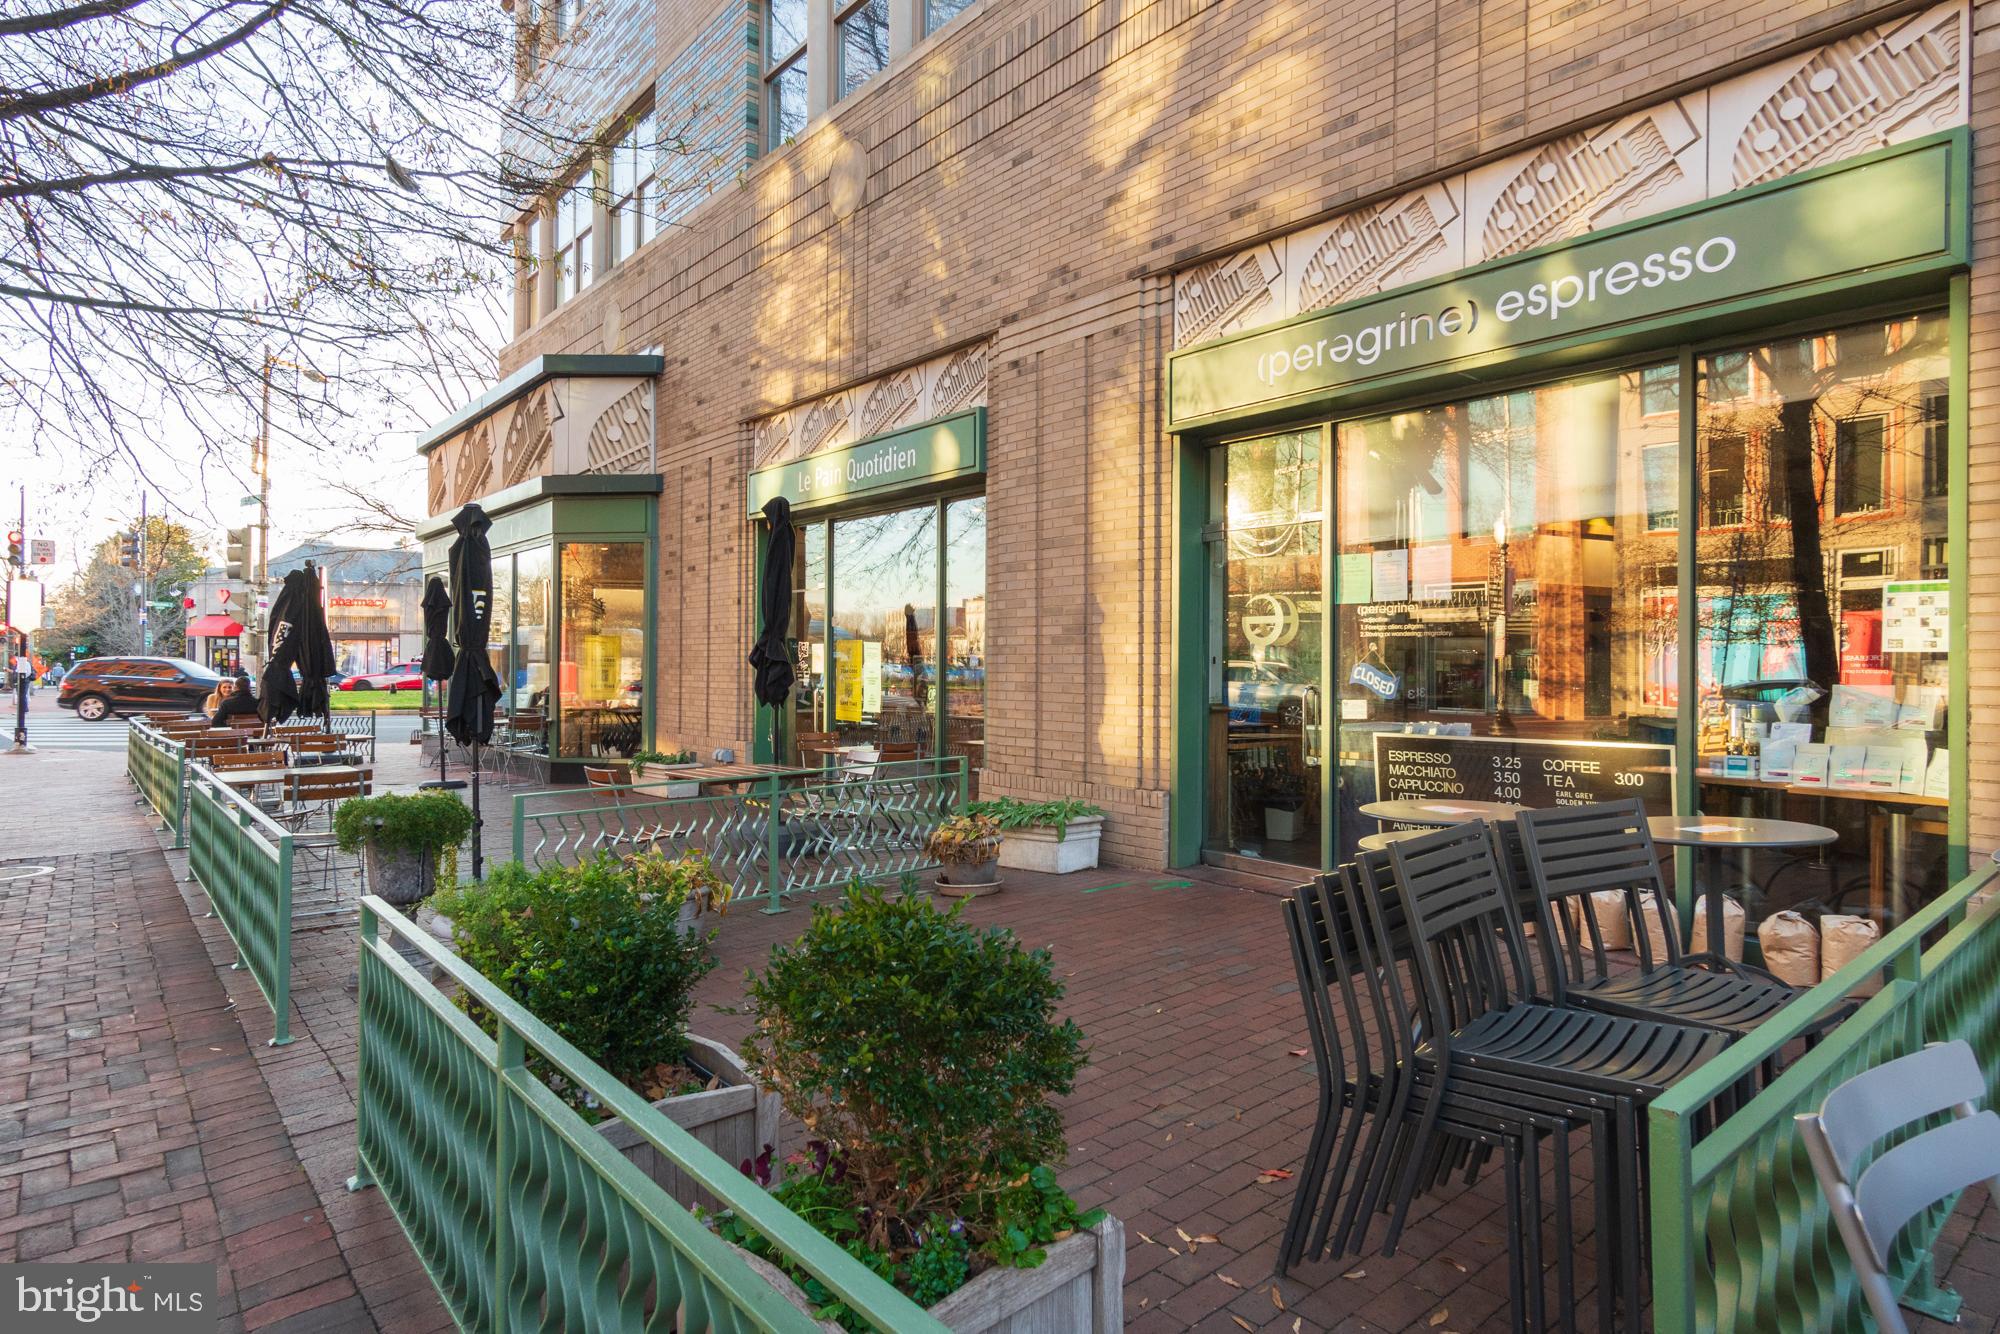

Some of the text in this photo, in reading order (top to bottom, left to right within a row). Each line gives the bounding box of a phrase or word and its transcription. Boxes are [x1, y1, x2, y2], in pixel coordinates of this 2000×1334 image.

[1496, 236, 1737, 322] espresso
[798, 446, 916, 492] Le Pain Quotidien
[329, 596, 387, 609] pharmacy
[1353, 666, 1395, 695] CLOSED
[1388, 750, 1521, 769] ESPRESSO 3.25
[1542, 759, 1600, 774] COFFEE
[1389, 764, 1520, 784] MACCHIATO 3.50
[1543, 774, 1575, 788] TEA
[1388, 777, 1521, 799] CAPPUCCINO 4.00
[1555, 790, 1593, 800] EARL GREY
[1555, 798, 1583, 806] GOLDEN
